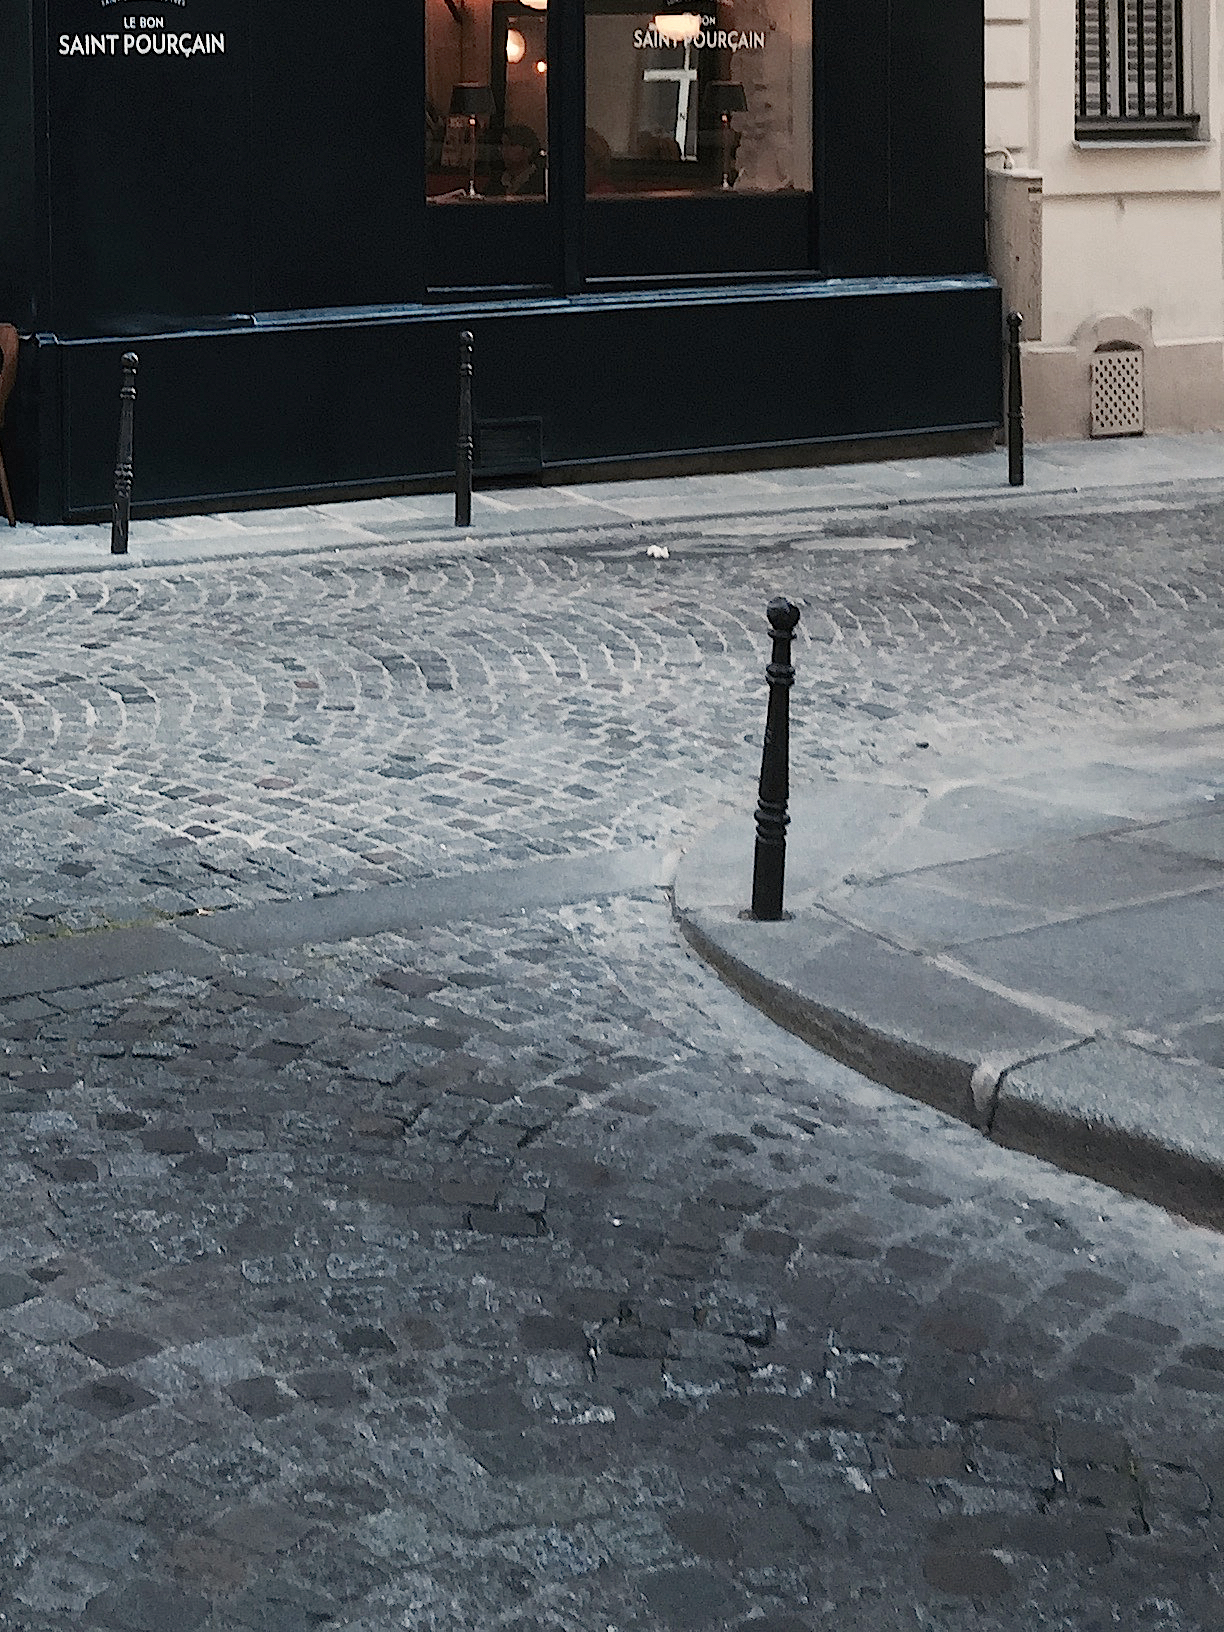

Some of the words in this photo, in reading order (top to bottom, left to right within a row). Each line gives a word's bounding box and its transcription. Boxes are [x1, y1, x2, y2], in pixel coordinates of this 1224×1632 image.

[123, 16, 136, 29] LE
[139, 16, 164, 29] BON
[58, 33, 119, 56] SAINT
[123, 33, 225, 59] POURÇAIN
